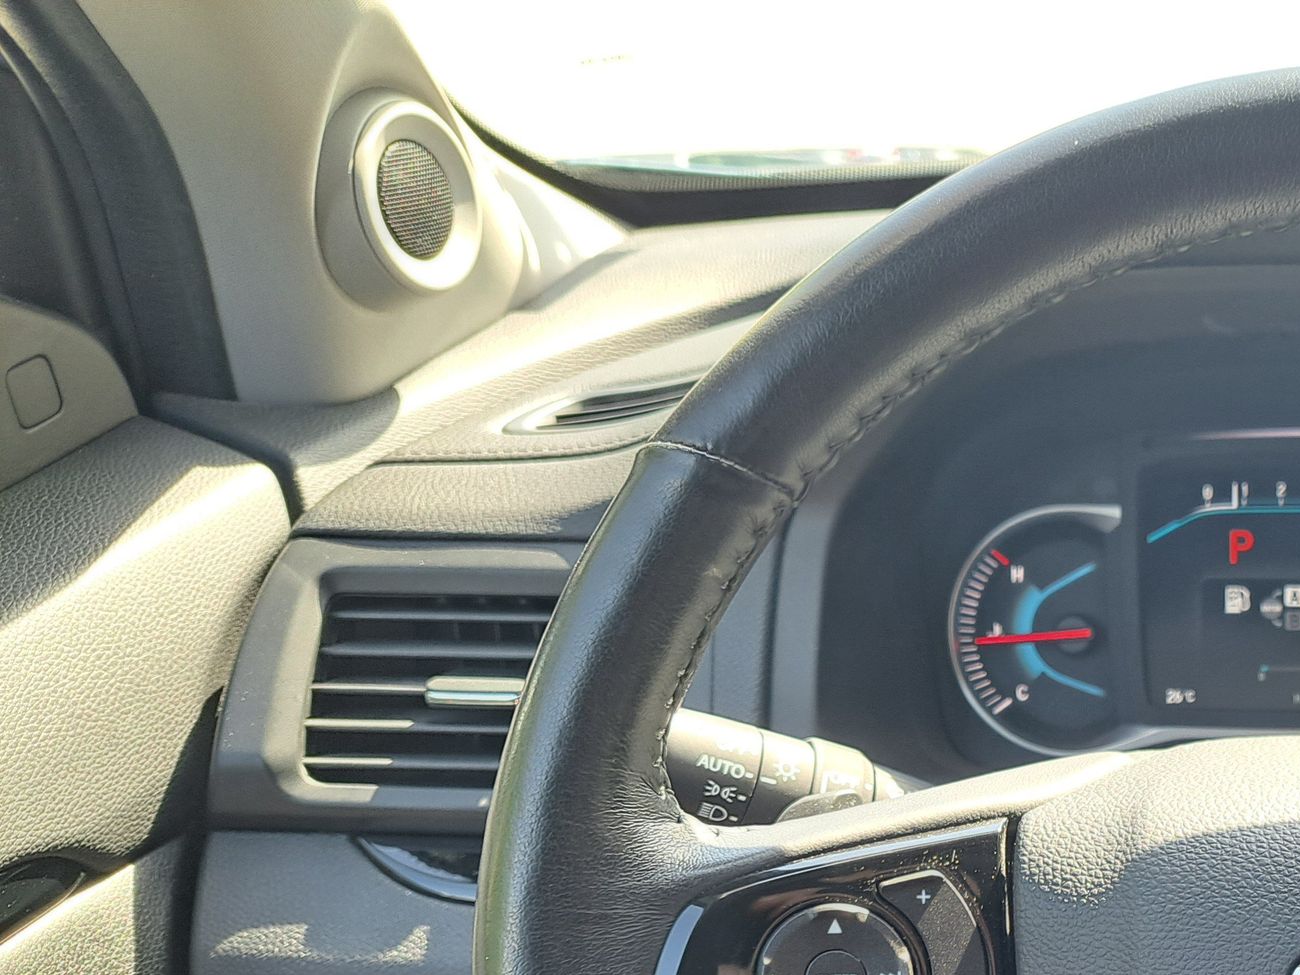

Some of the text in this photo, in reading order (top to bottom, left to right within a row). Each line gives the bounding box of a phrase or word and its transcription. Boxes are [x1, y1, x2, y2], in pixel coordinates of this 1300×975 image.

[1228, 529, 1255, 564] P
[1015, 684, 1029, 701] C
[696, 754, 746, 779] AUTO
